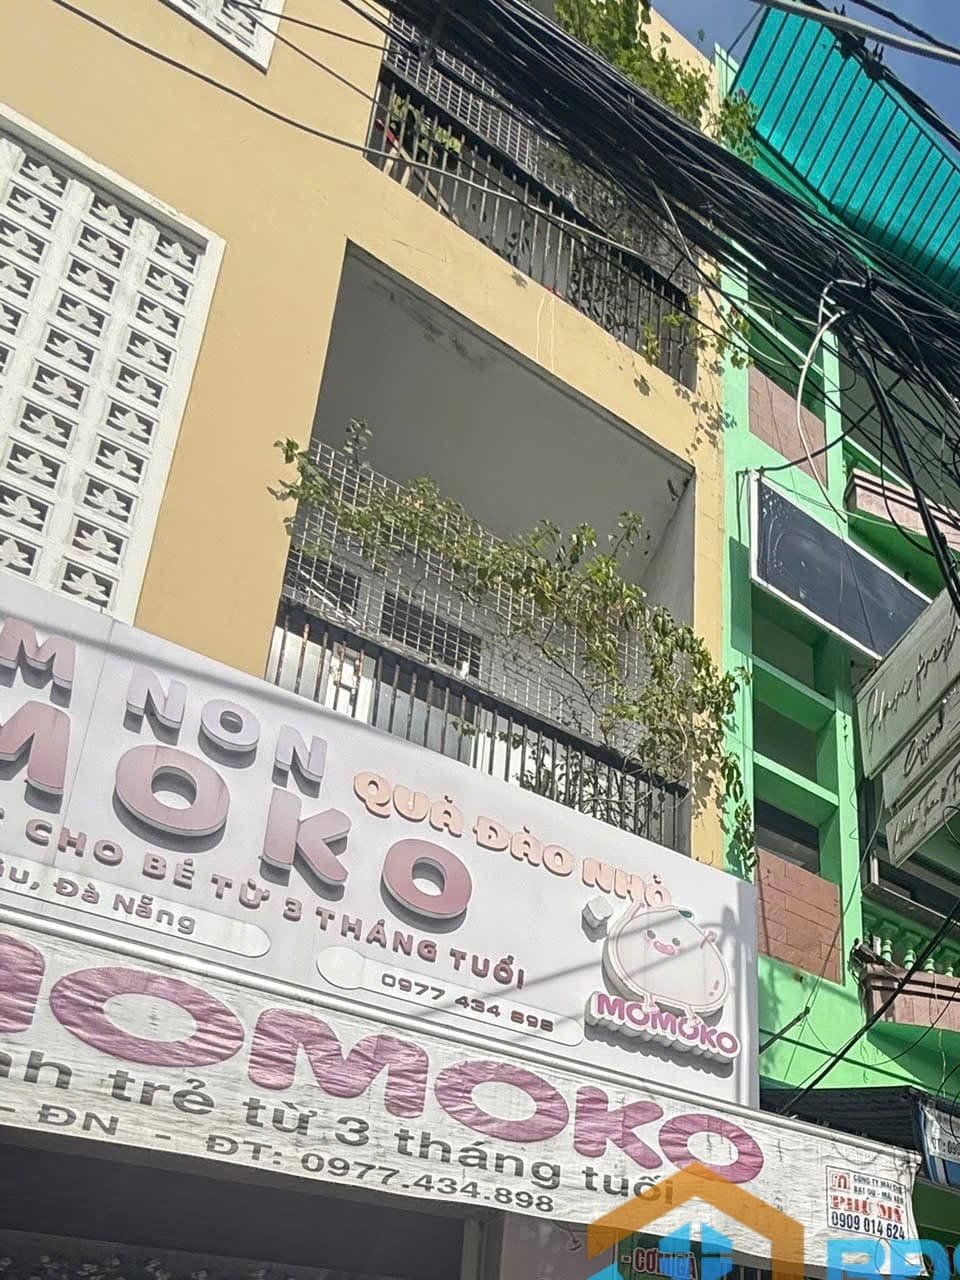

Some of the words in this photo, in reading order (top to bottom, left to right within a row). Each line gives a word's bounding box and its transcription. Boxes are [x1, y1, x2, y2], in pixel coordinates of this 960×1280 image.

[124, 664, 328, 782] NON
[25, 819, 124, 866] CHO
[142, 852, 196, 890] BÉ
[211, 873, 271, 910] TỪ
[283, 897, 303, 922] 3
[315, 906, 438, 963] THÁNG
[450, 948, 526, 990] TUỔI
[53, 876, 101, 905] Đà
[112, 893, 196, 936] Nẵng
[473, 814, 574, 876] ĐÀO
[582, 857, 672, 907] NHỎ
[381, 973, 446, 1001] 0977
[454, 995, 501, 1018] 434
[510, 1009, 554, 1032] 898
[596, 993, 739, 1055] MOMOKO
[38, 1103, 120, 1136] ĐN
[205, 1134, 282, 1165] ĐT:
[300, 1153, 555, 1212] 0977.434.898
[108, 1069, 216, 1115] trẻ
[242, 1097, 317, 1136] từ
[335, 1116, 370, 1147] 3
[394, 1128, 561, 1189] tháng
[831, 1211, 861, 1231] 0909
[863, 1217, 883, 1236] 014
[886, 1223, 905, 1240] 624
